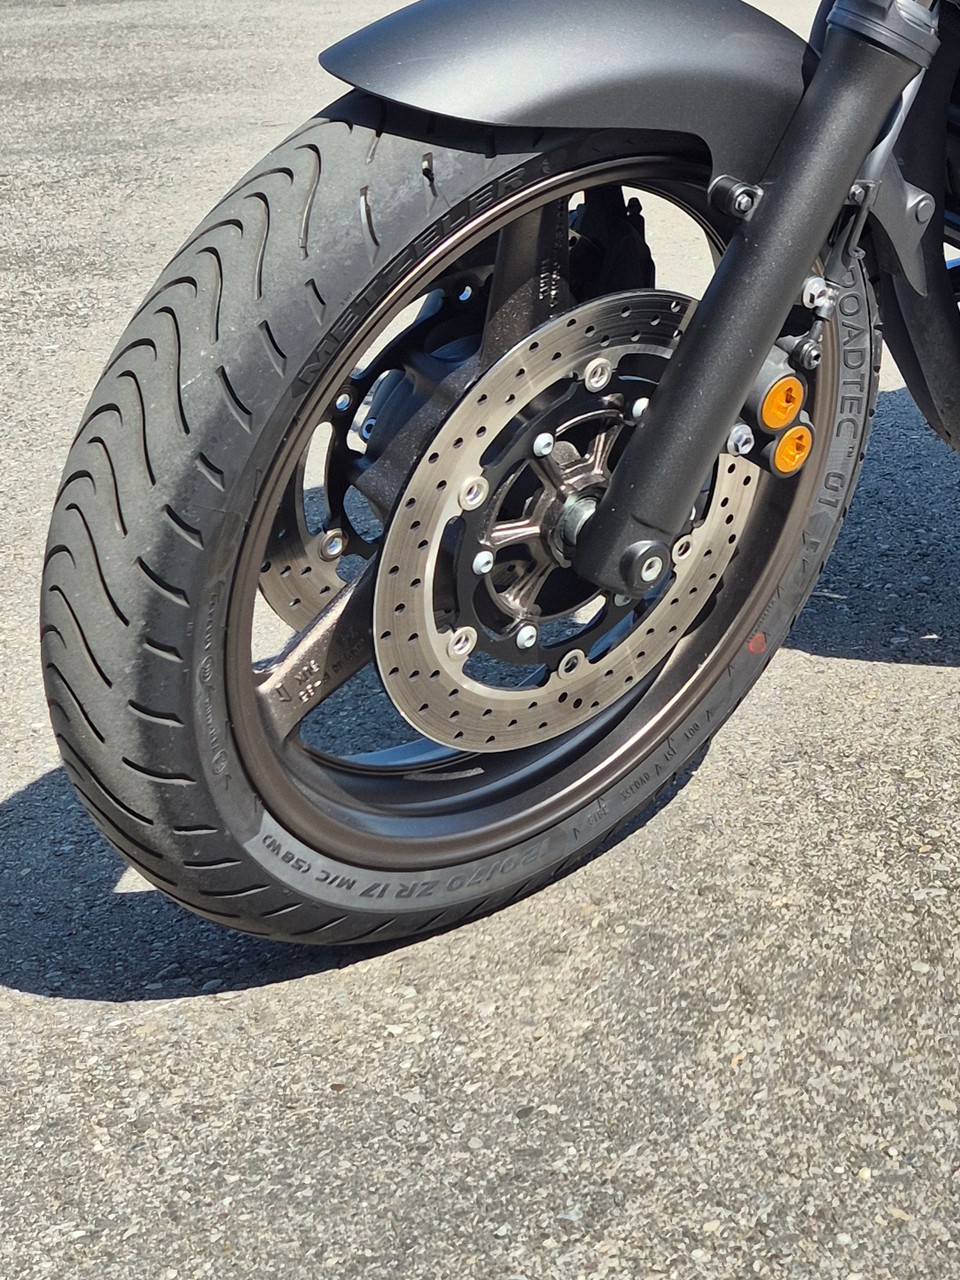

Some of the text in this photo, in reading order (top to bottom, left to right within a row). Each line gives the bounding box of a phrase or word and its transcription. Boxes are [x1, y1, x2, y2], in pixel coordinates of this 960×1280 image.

[298, 166, 527, 386] METZELER
[818, 471, 846, 510] 01
[314, 869, 358, 891] M/C
[358, 882, 392, 900] 17
[393, 878, 442, 901] ZR
